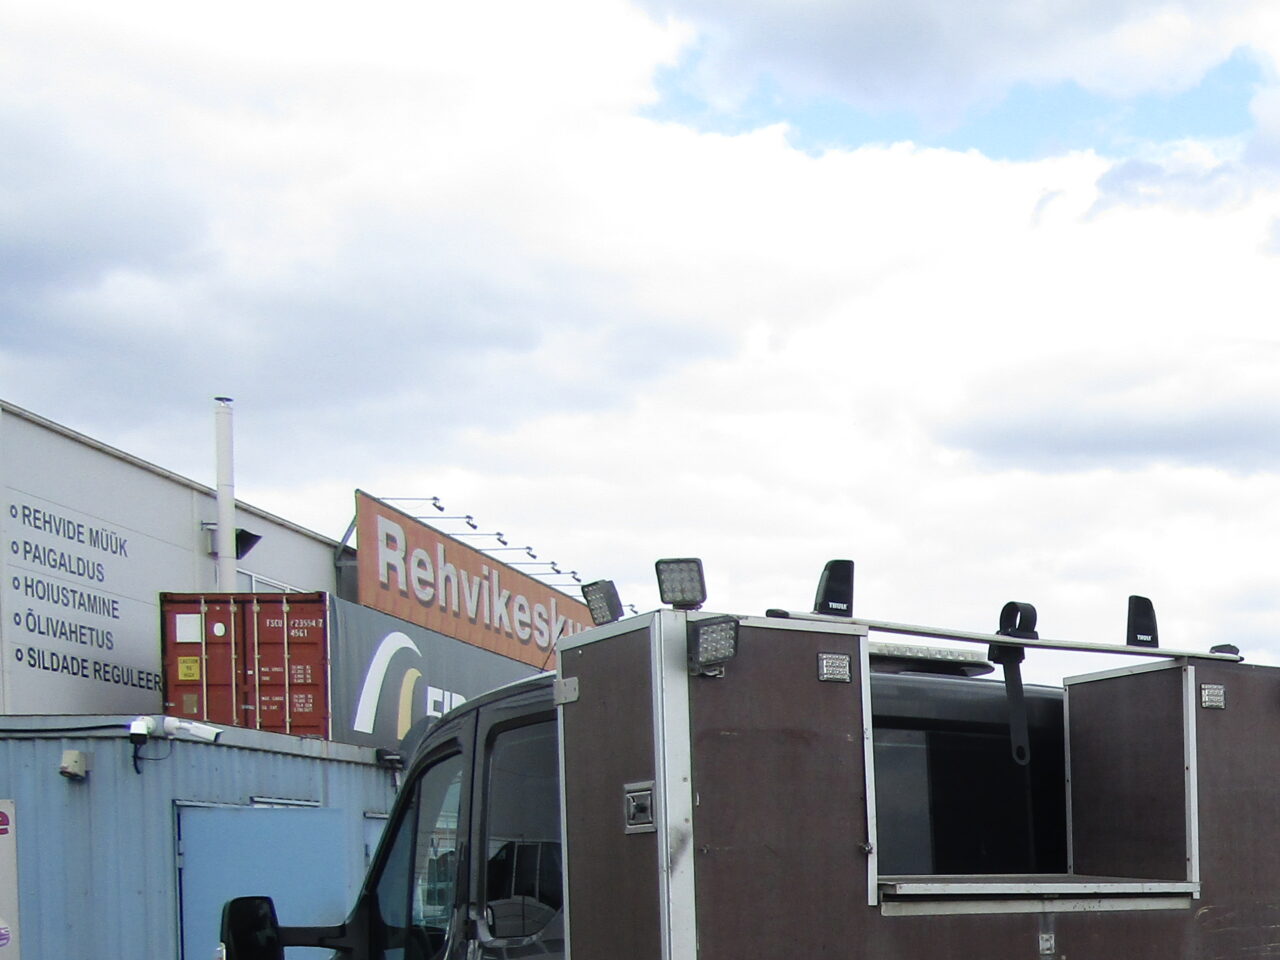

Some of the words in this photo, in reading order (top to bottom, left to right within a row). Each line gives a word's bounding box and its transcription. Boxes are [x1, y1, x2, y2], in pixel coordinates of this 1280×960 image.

[22, 505, 85, 544] REHVIDE
[89, 527, 128, 558] MÜÜK
[23, 540, 105, 582] PAIGALDUS
[24, 576, 120, 619] HOIUSTAMINE
[377, 514, 592, 651] Rehvikesk
[828, 601, 848, 610] THULE
[26, 608, 114, 650] ÕLIVAHETUS
[28, 647, 90, 678] SILDADE
